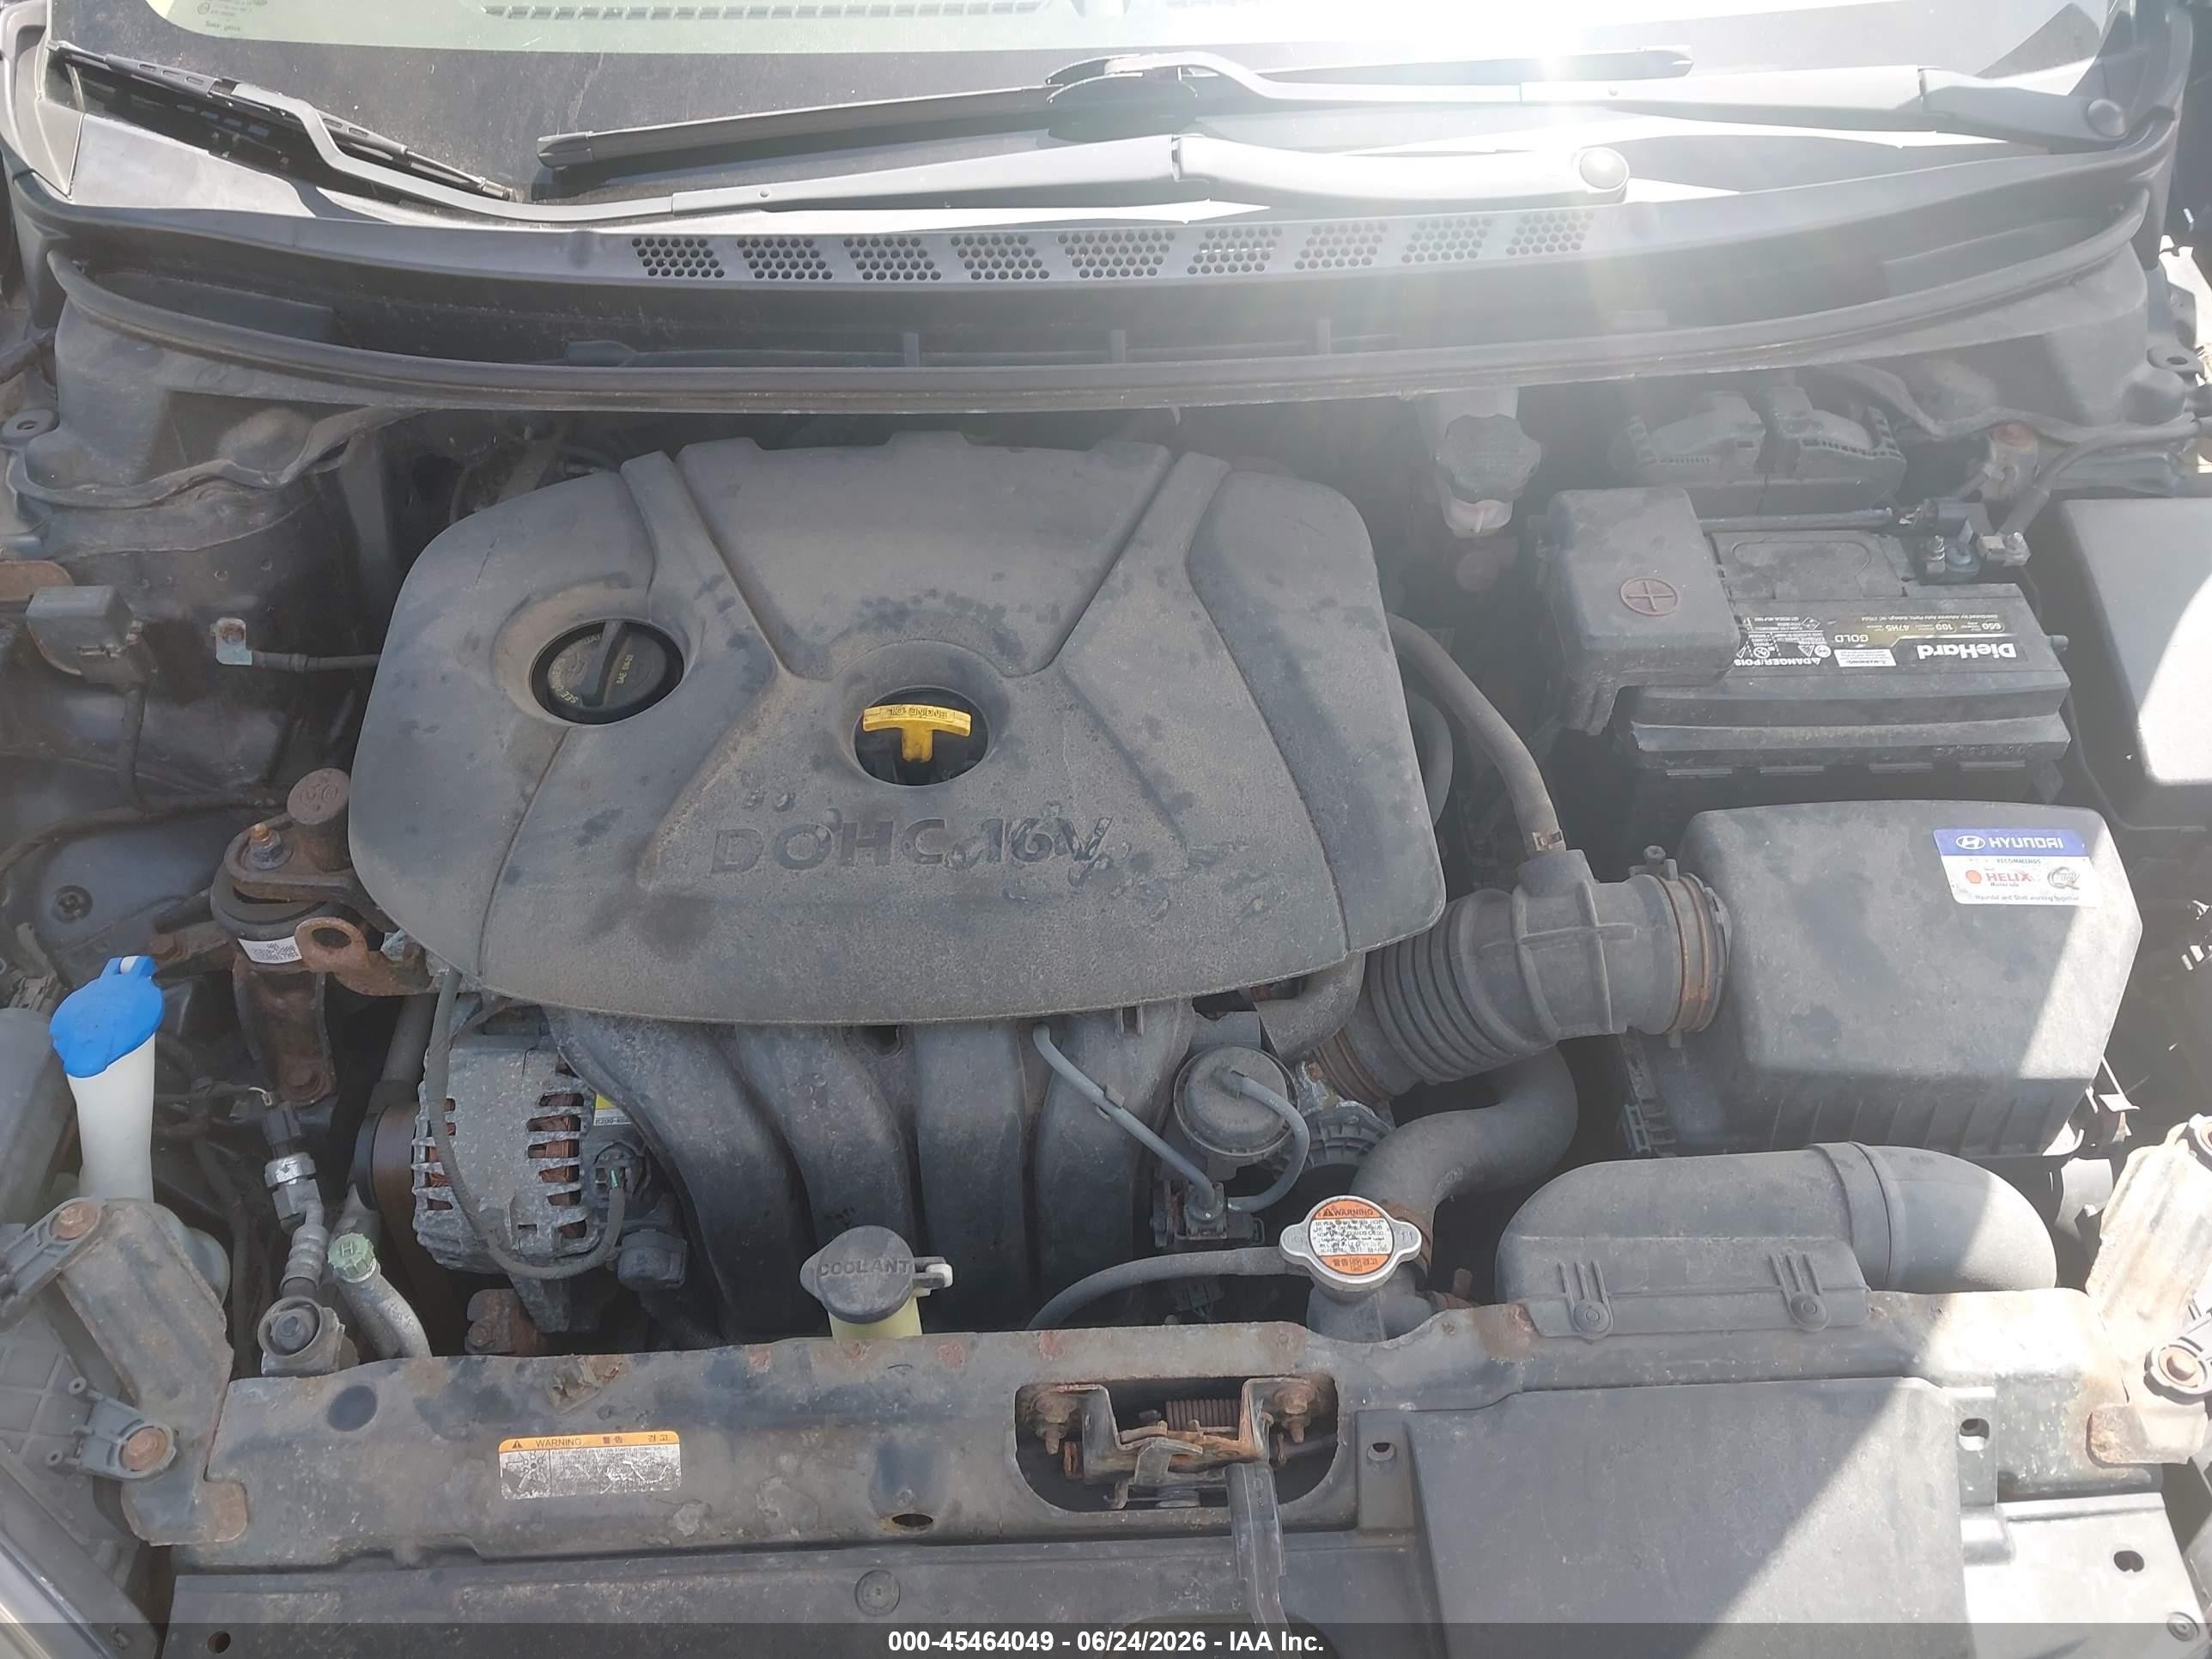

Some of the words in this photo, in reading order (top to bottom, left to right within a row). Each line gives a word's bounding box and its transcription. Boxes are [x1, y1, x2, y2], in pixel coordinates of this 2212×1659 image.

[1936, 623, 1954, 631] 100
[1834, 634, 1869, 643] GOLD
[1917, 642, 2017, 659] DieHard
[562, 690, 580, 703] SEE
[888, 707, 904, 716] OIL
[909, 707, 947, 718] ENGINE
[711, 818, 946, 873] DOHC
[980, 816, 1114, 864] 16V
[1988, 837, 2064, 849] HYUNDAI
[1985, 872, 2033, 882] HELIX
[1334, 1209, 1374, 1218] WARNING
[340, 1241, 354, 1256] H
[818, 1260, 910, 1277] COOLANT
[536, 1437, 582, 1449] WARNING
[647, 1434, 669, 1443] 경고
